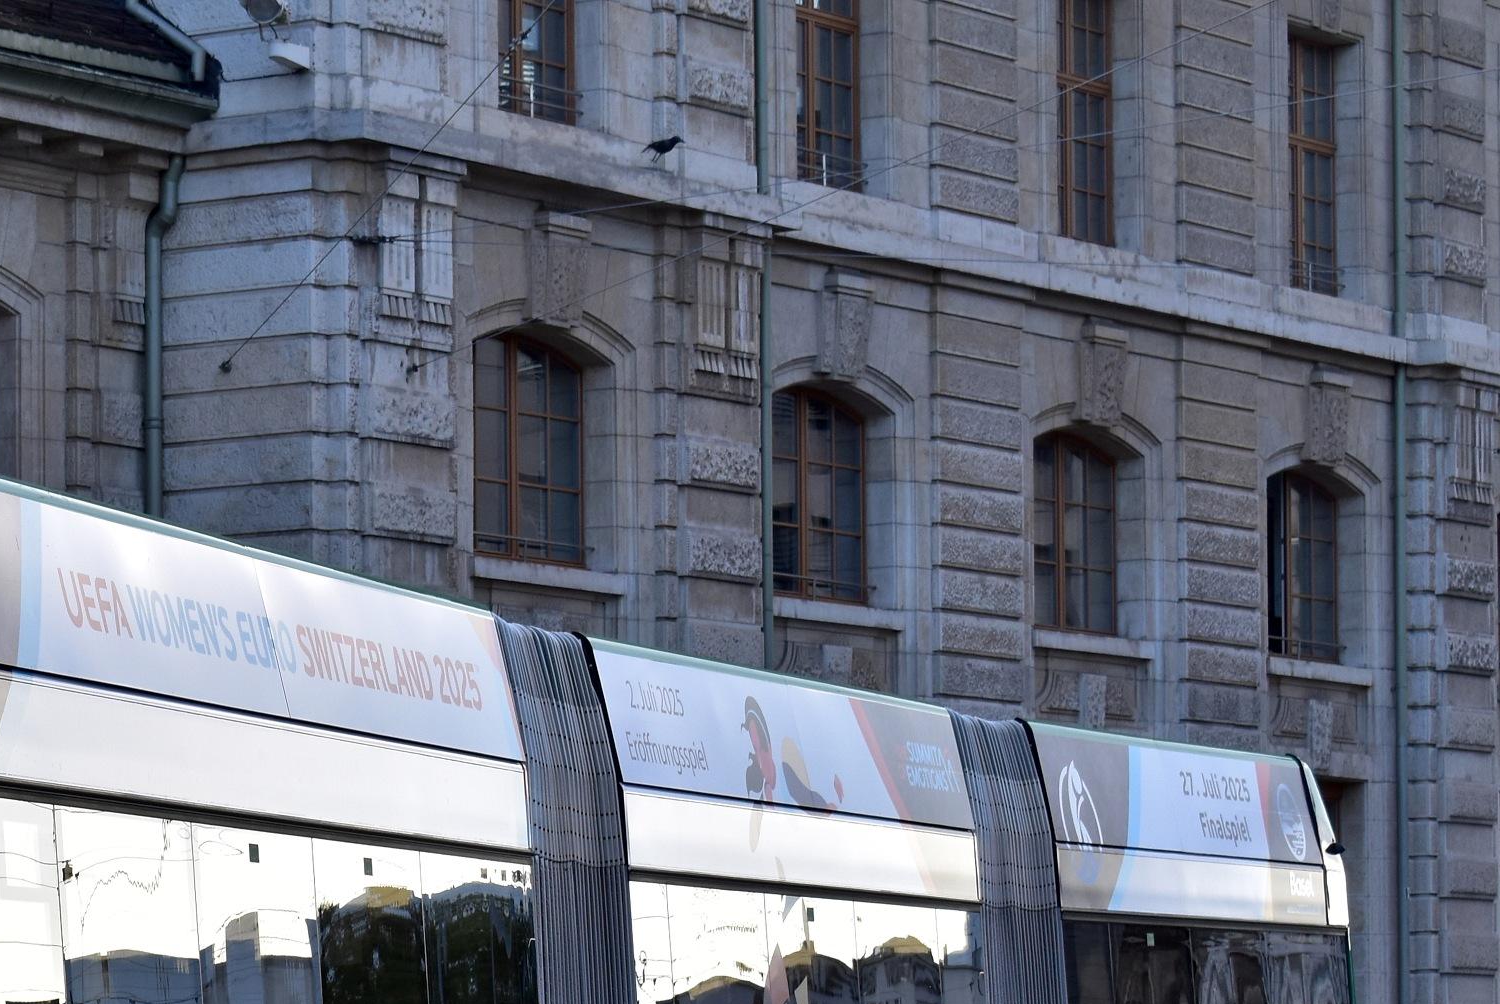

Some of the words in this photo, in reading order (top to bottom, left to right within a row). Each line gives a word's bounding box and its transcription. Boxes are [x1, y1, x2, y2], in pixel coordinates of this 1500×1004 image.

[57, 567, 134, 639] UEFA
[126, 584, 237, 662] WOMEN'S
[236, 611, 297, 674] EURO
[296, 623, 434, 701] SWITZERLAND
[433, 654, 483, 712] 2025
[638, 680, 658, 712] Juli
[656, 686, 684, 717] 2025
[625, 731, 709, 776] Eröffnungsspiel
[1180, 770, 1200, 797] 27.
[1201, 772, 1221, 800] Juli
[1221, 776, 1250, 802] 2025
[1199, 813, 1252, 847] Finalspiel
